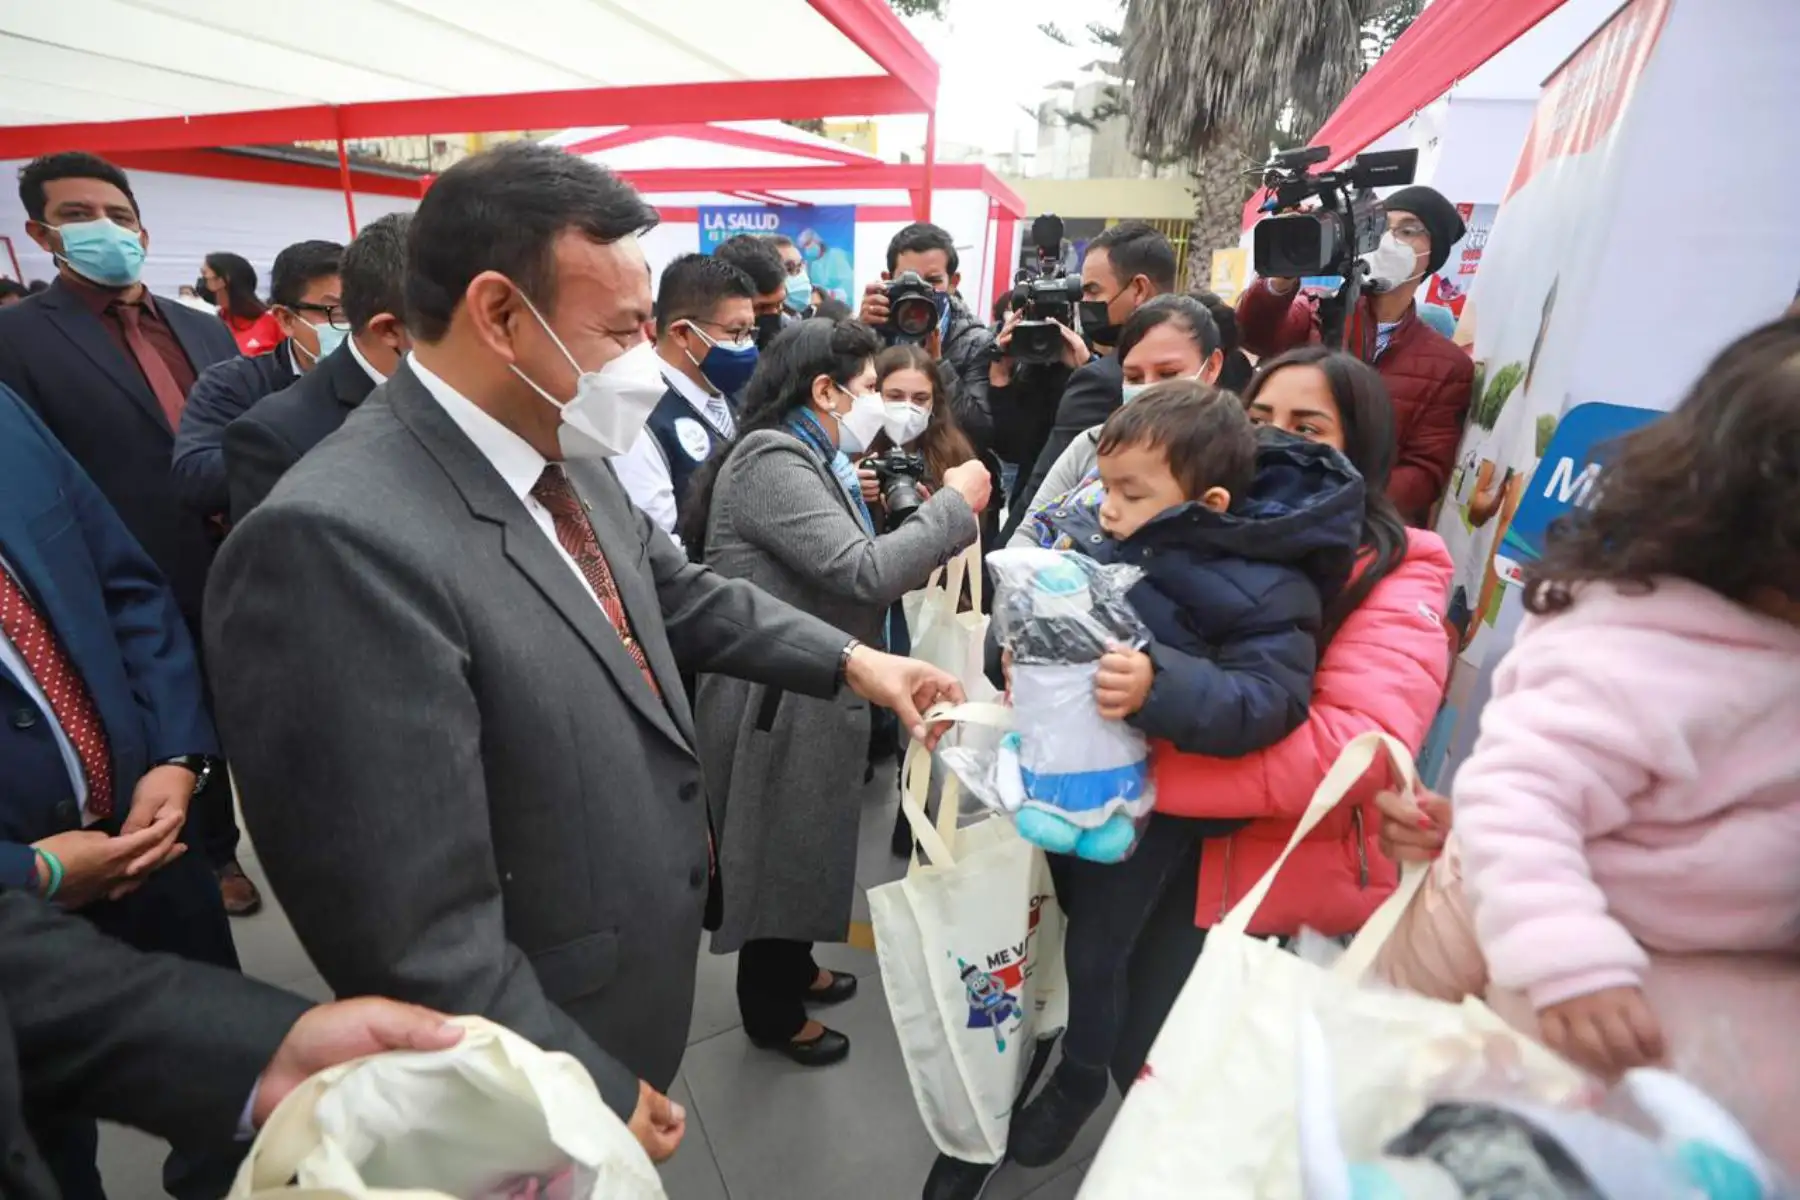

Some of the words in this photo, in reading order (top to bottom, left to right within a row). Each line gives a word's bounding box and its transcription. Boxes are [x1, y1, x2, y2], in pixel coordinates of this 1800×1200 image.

[704, 213, 725, 230] LA
[727, 213, 780, 230] SALUD
[986, 948, 1011, 969] ME
